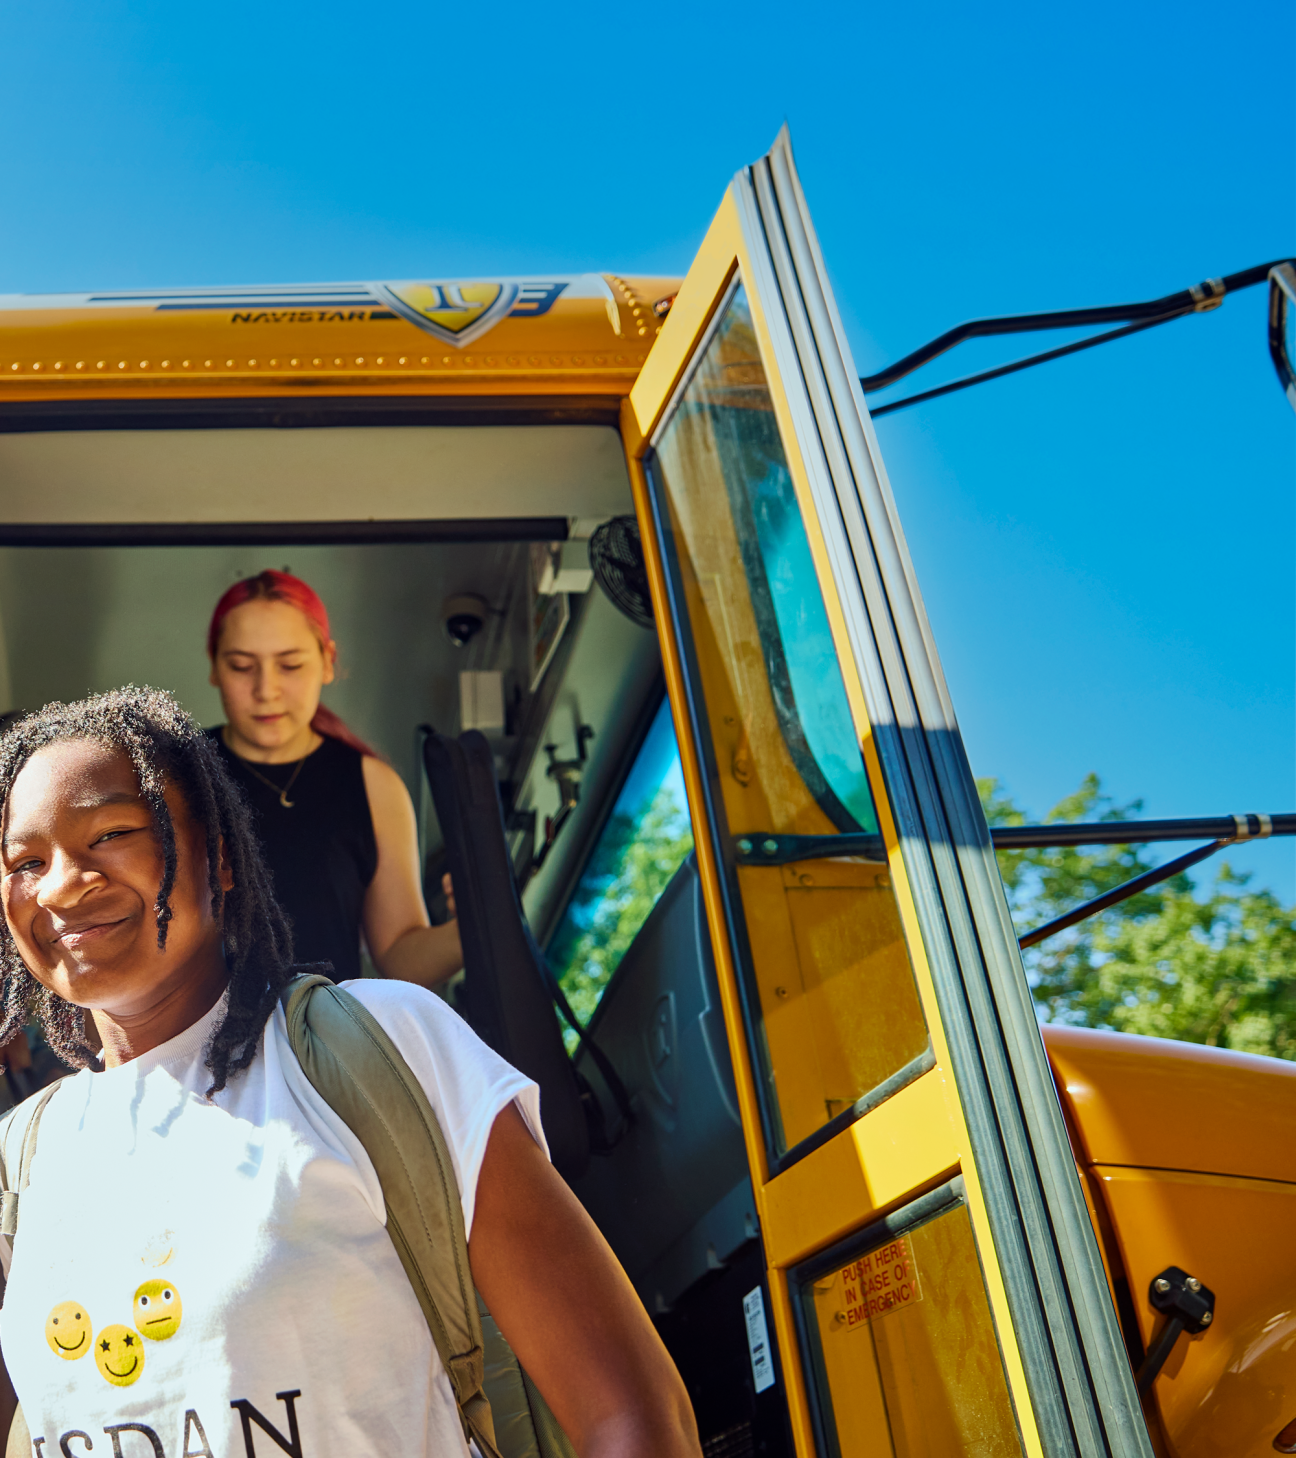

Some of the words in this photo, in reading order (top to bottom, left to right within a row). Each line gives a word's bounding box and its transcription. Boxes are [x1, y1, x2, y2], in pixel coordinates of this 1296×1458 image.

[231, 310, 365, 323] NAVISTAR
[842, 1256, 872, 1285] PUSH
[874, 1239, 907, 1268] HERE
[845, 1286, 857, 1305] IN
[860, 1270, 891, 1297] CASE
[894, 1260, 910, 1281] OF
[847, 1280, 916, 1325] EMERGENCY
[32, 1388, 305, 1458] SDAN
